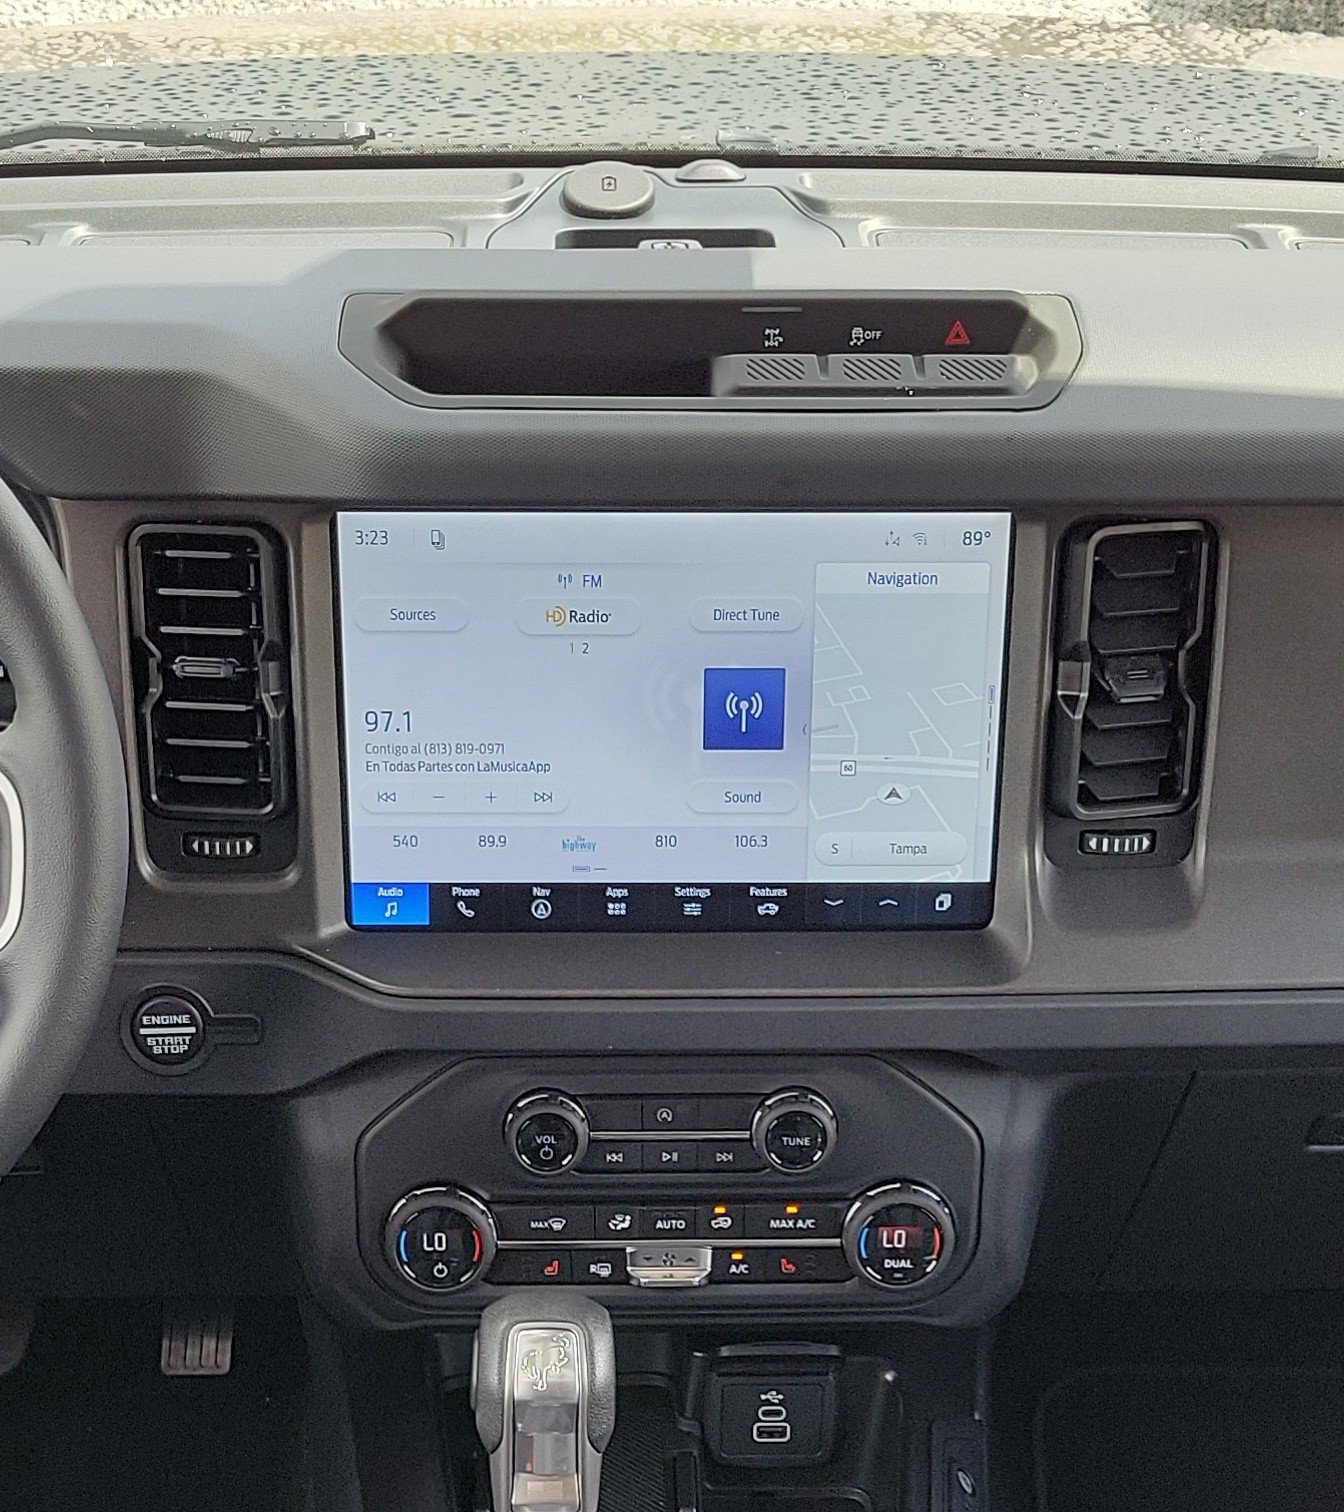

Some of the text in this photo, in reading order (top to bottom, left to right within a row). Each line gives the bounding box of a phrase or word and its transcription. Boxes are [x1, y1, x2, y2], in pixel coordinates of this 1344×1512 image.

[864, 329, 883, 340] OFF
[355, 529, 389, 546] 3:23
[962, 530, 991, 546] 89°
[582, 574, 603, 588] FM
[867, 571, 938, 588] Navigation
[390, 607, 437, 622] Sources
[713, 608, 780, 622] Direct Tune
[582, 642, 589, 654] 2
[364, 710, 413, 733] 97.1
[365, 742, 505, 757] Contigo al (813) 819-0971
[366, 760, 551, 774] En Todas Partes con LaMusicaApp
[724, 790, 761, 804] Sound
[393, 835, 419, 848] 540
[478, 835, 507, 848] 89.9
[655, 835, 677, 848] 810
[734, 835, 768, 848] 106.3
[830, 843, 839, 855] S
[889, 843, 928, 857] Tampa
[377, 886, 403, 898] Audio
[452, 886, 481, 898] Phone
[532, 886, 551, 898] Nav
[605, 886, 629, 899] Apps
[674, 886, 711, 899] Settings
[749, 886, 788, 898] Features
[141, 1014, 192, 1025] ENGINE
[146, 1035, 192, 1046] START
[152, 1045, 189, 1055] STOP
[535, 1134, 557, 1144] VOL
[781, 1136, 811, 1147] TUNE
[530, 1220, 549, 1229] MAX
[655, 1219, 686, 1230] AUTO
[769, 1218, 816, 1230] MAX A/C
[422, 1232, 447, 1251] LO
[882, 1229, 906, 1248] LO
[729, 1262, 750, 1274] A/C
[884, 1259, 914, 1269] DUAL
